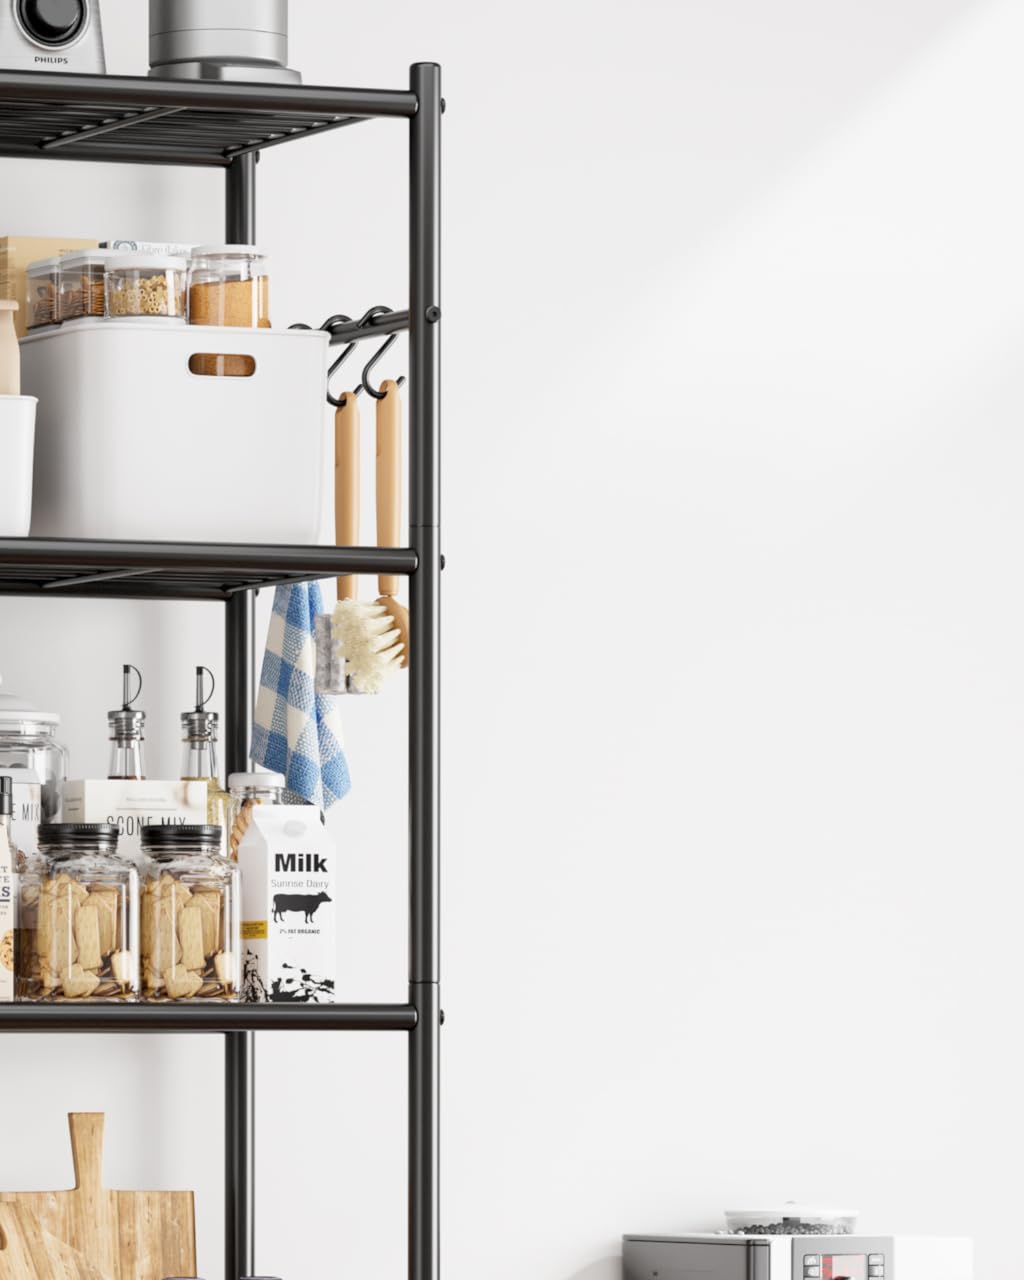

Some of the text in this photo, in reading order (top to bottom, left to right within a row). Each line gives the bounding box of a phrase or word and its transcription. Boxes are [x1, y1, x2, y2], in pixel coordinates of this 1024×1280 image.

[34, 56, 68, 65] PHILIPS
[275, 853, 328, 873] Milk
[271, 880, 329, 889] Sunrise Dairy
